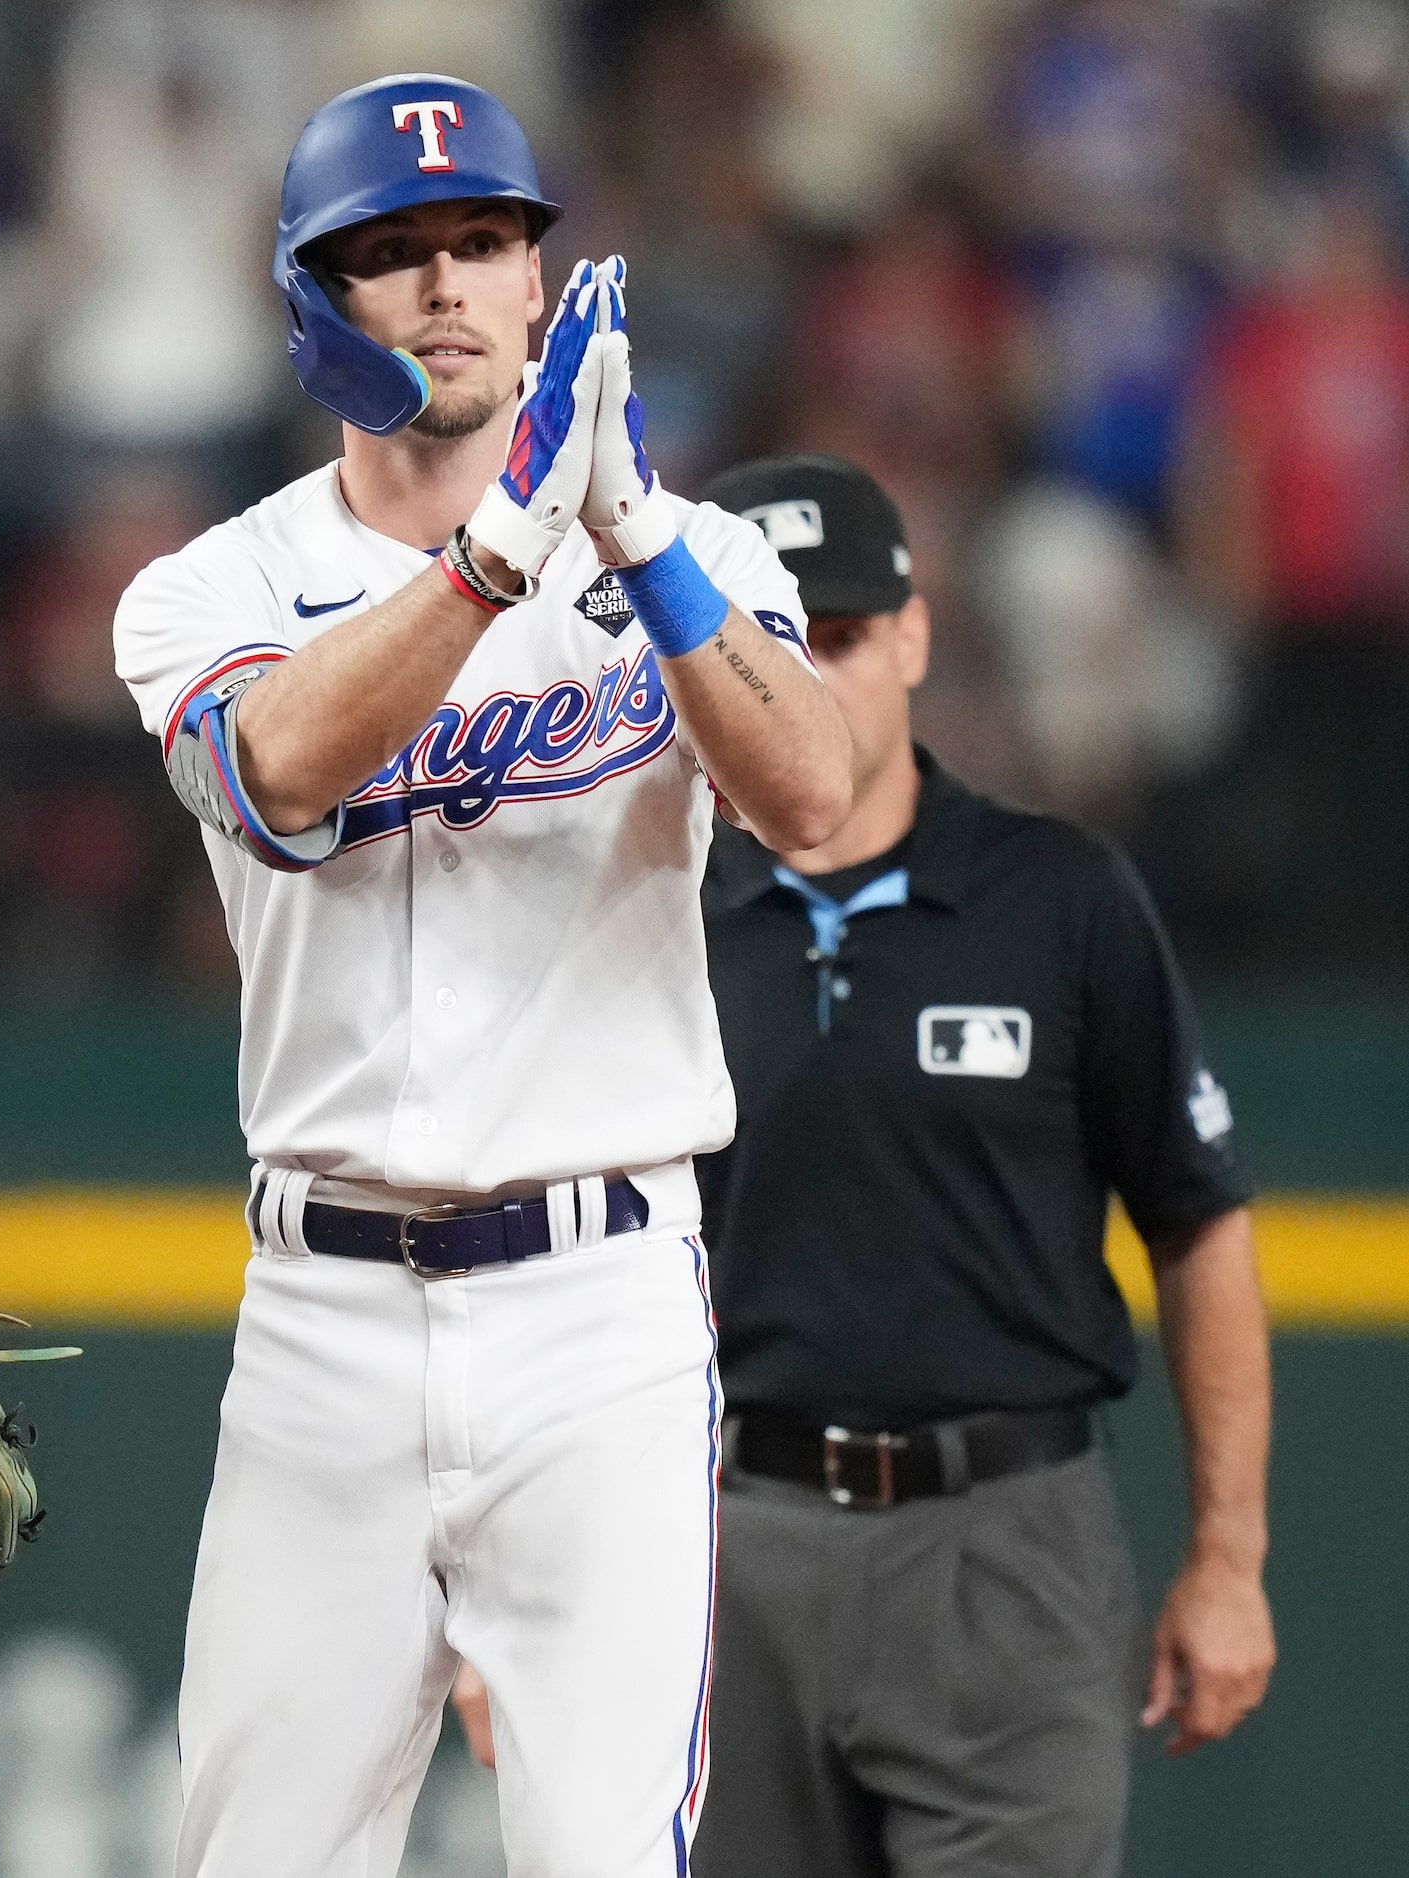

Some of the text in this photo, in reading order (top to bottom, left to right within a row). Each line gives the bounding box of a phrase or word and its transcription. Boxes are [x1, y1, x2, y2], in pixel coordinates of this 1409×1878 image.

[392, 100, 464, 173] T
[585, 588, 629, 604] WOR
[585, 599, 633, 617] SERIE
[344, 642, 675, 832] ngers
